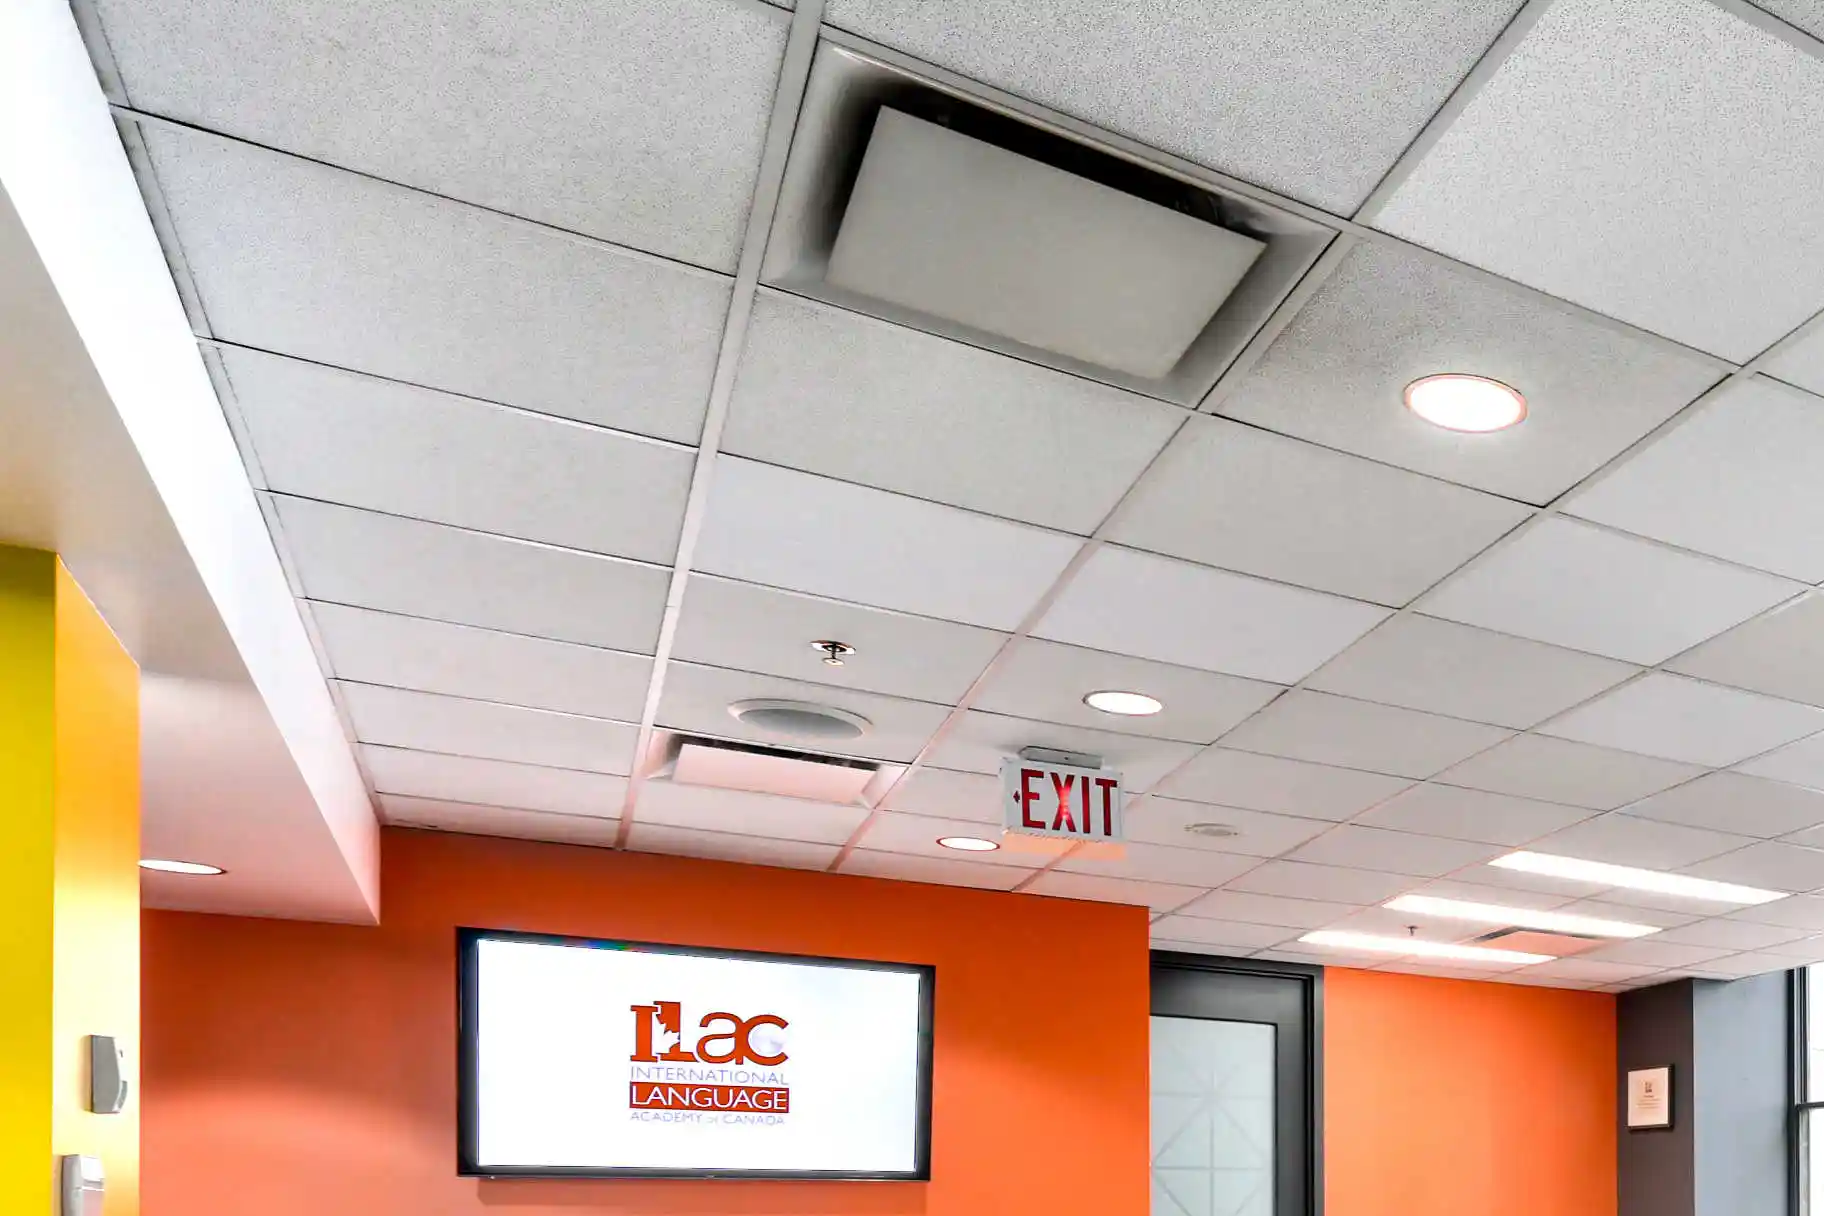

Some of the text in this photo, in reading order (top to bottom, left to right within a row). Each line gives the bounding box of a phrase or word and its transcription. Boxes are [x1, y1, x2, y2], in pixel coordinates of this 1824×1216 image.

[1021, 768, 1118, 836] EXIT
[630, 1066, 789, 1085] INTERNATIONAL
[631, 1085, 788, 1110] LANGUAGE
[630, 1111, 702, 1124] ACADEMY
[722, 1113, 786, 1126] CANADA
